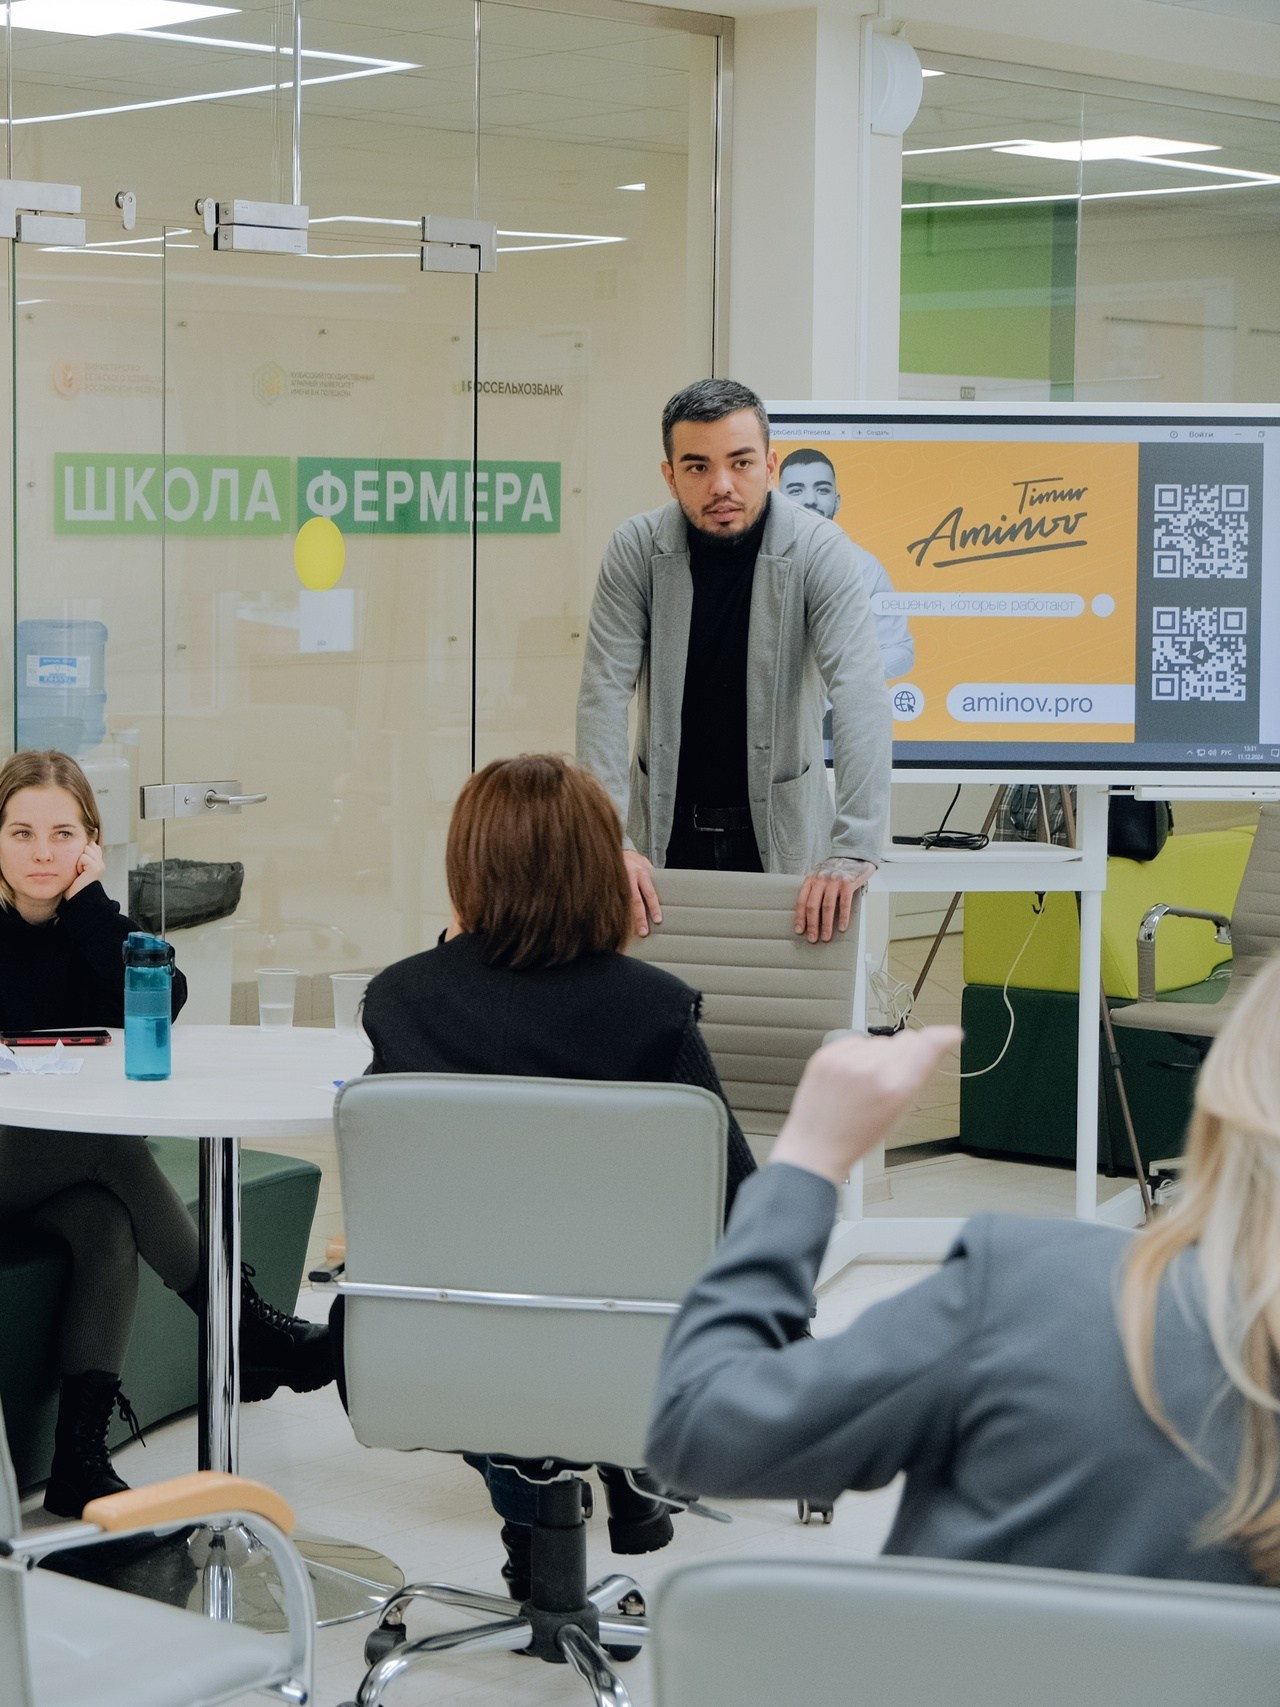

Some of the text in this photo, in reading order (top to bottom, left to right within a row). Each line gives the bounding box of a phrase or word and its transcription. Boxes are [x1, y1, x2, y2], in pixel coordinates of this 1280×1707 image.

[467, 380, 564, 396] РОССЕЛЬХОЗБАНК
[1188, 430, 1214, 438] Войти
[64, 464, 553, 524] ШКОЛА ФЕРМЕРА
[1013, 477, 1089, 515] Timur
[907, 506, 1088, 567] Aminov
[881, 597, 1075, 612] решения, которые работают
[962, 690, 1093, 718] aminov.pro
